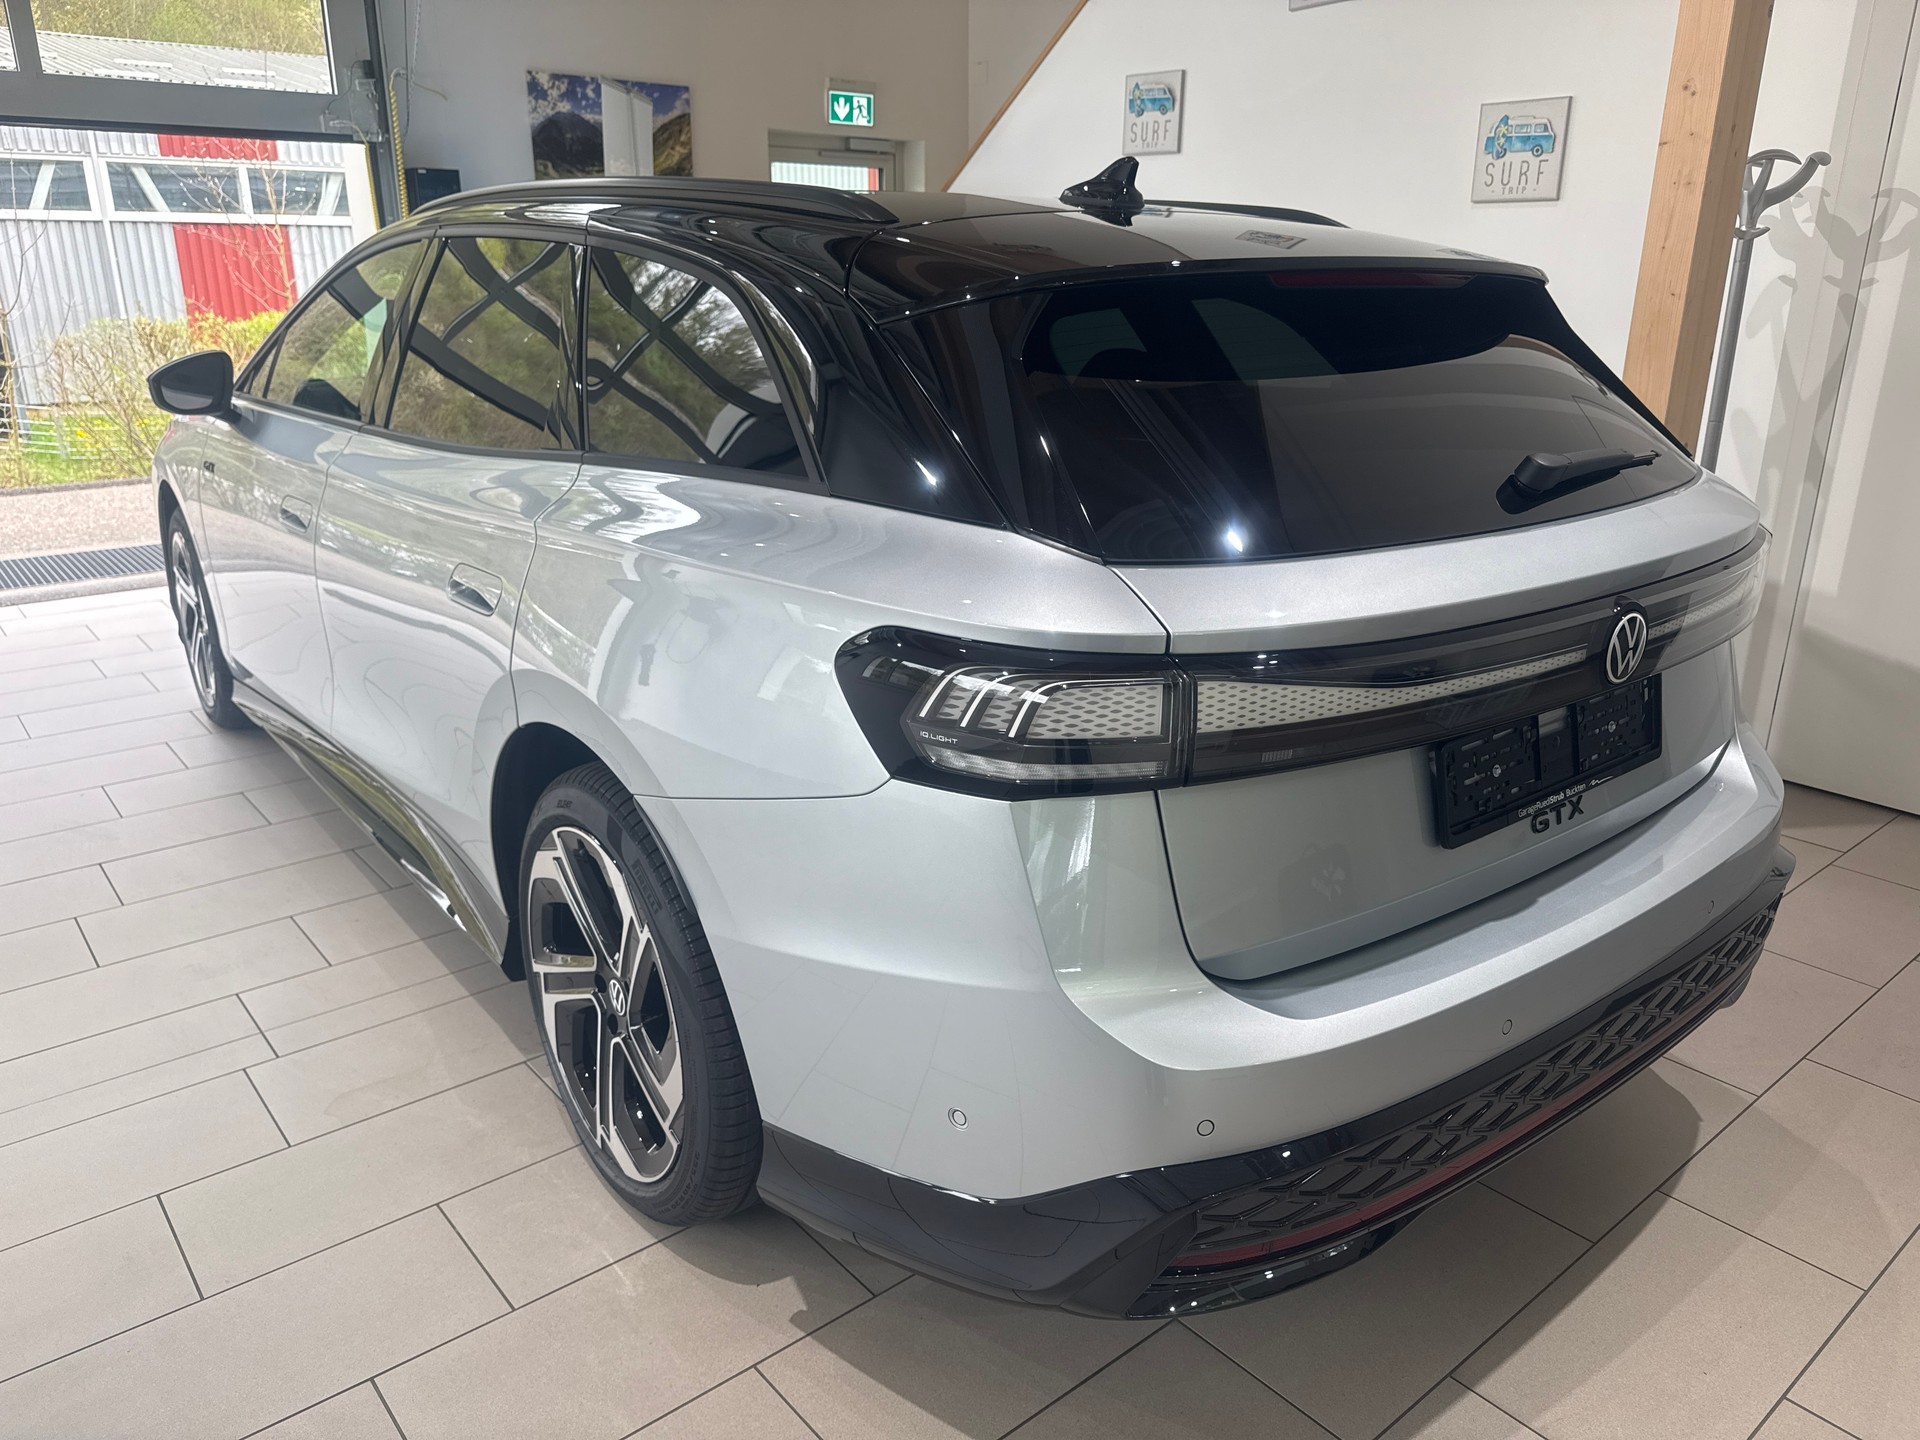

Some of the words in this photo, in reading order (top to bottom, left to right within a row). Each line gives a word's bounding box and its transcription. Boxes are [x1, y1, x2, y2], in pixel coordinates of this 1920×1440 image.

[1130, 119, 1172, 143] SURF
[1484, 159, 1549, 187] SURF
[1501, 186, 1527, 195] TRIP
[1531, 795, 1584, 834] GTX
